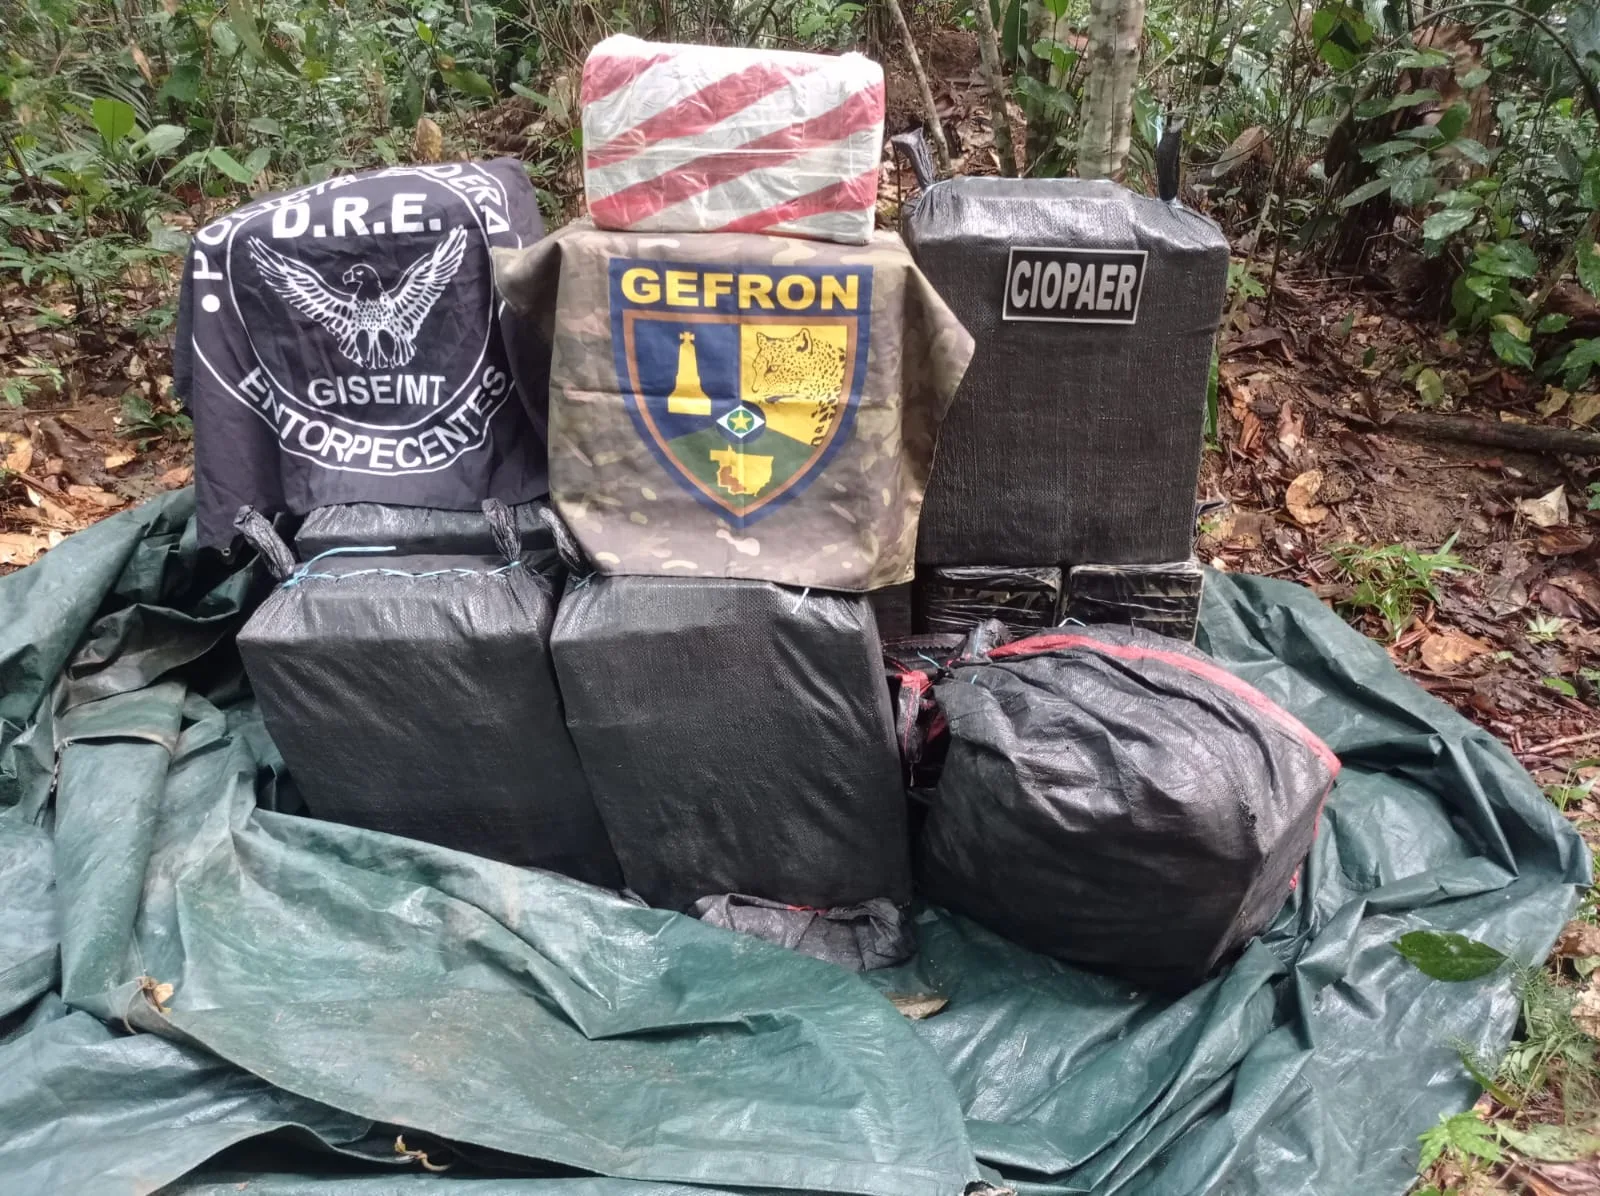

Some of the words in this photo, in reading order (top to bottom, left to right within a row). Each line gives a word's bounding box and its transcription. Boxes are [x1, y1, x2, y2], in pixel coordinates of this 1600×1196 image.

[272, 193, 442, 239] D.R.E.
[621, 268, 860, 311] GEFRON
[1010, 260, 1138, 312] CIOPAER
[307, 374, 447, 406] GISE/MT
[238, 365, 508, 470] ENTORPECENTES
